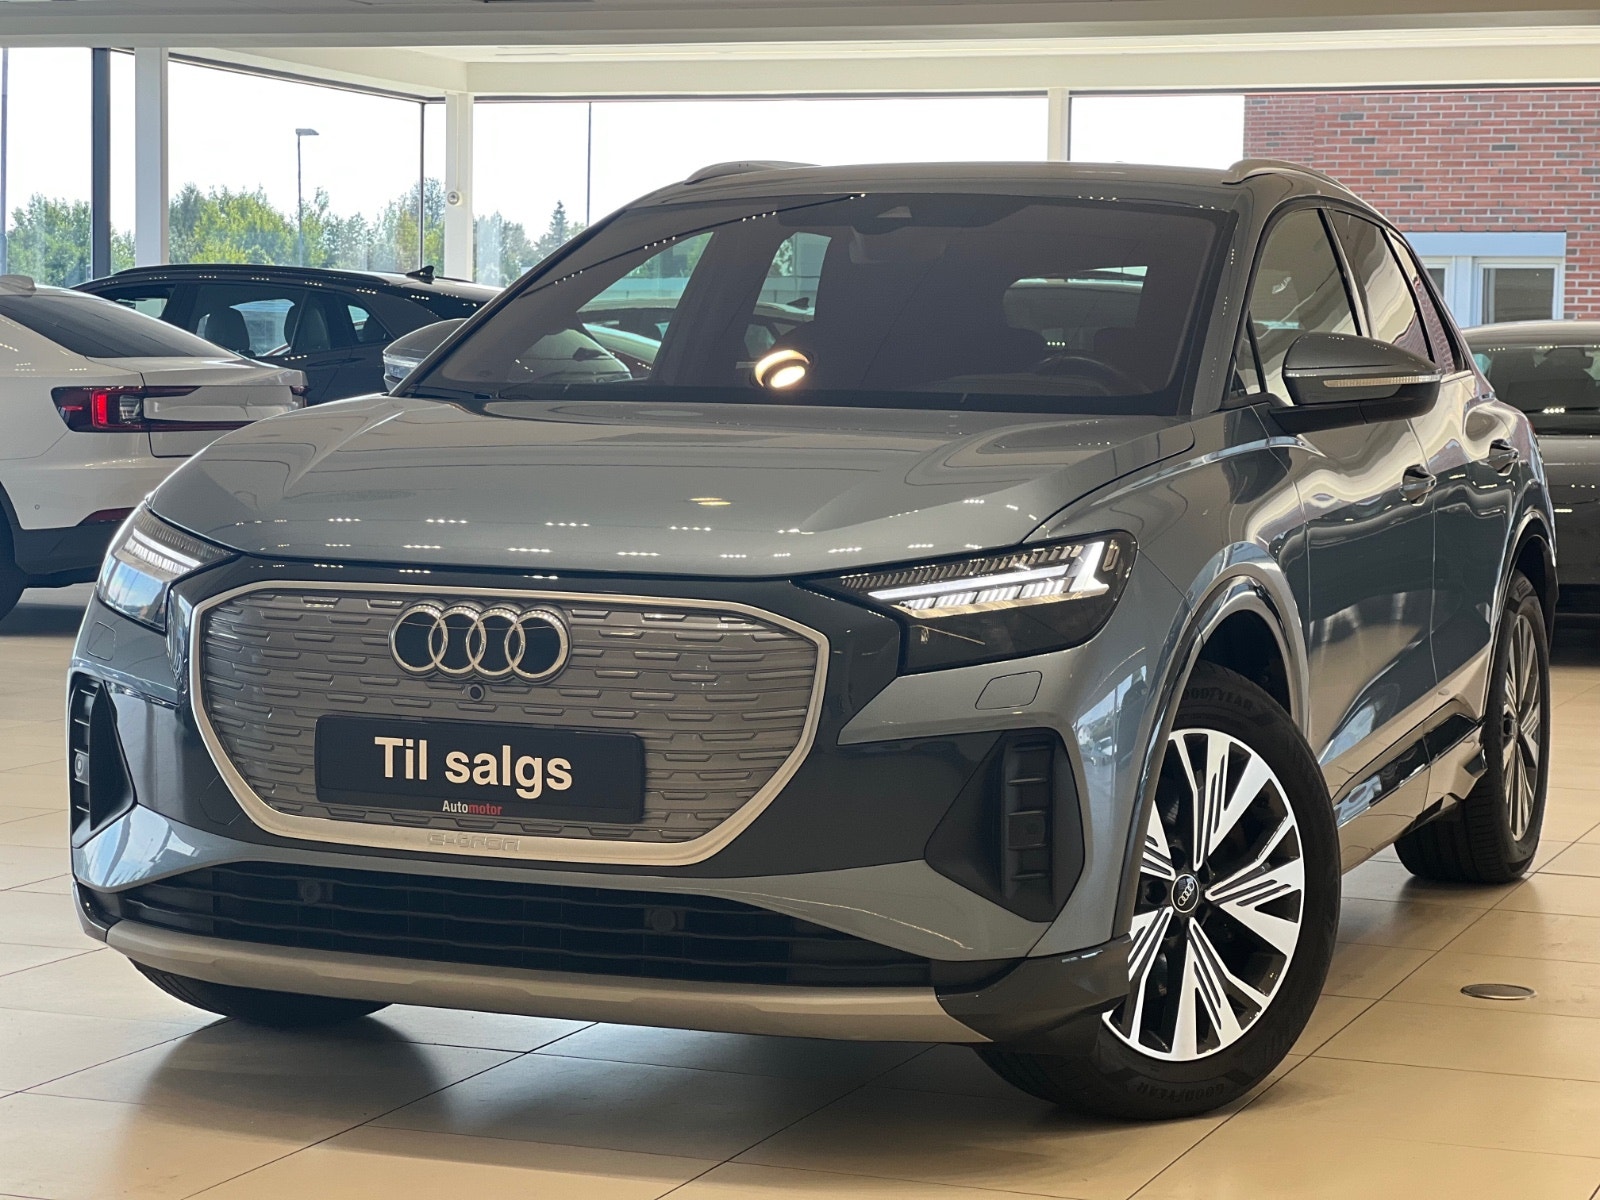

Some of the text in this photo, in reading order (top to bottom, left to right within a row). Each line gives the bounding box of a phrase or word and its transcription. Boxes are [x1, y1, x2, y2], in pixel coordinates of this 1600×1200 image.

[1182, 686, 1254, 712] OODYEAR
[374, 736, 573, 799] Til salgs
[442, 800, 503, 816] Automotor
